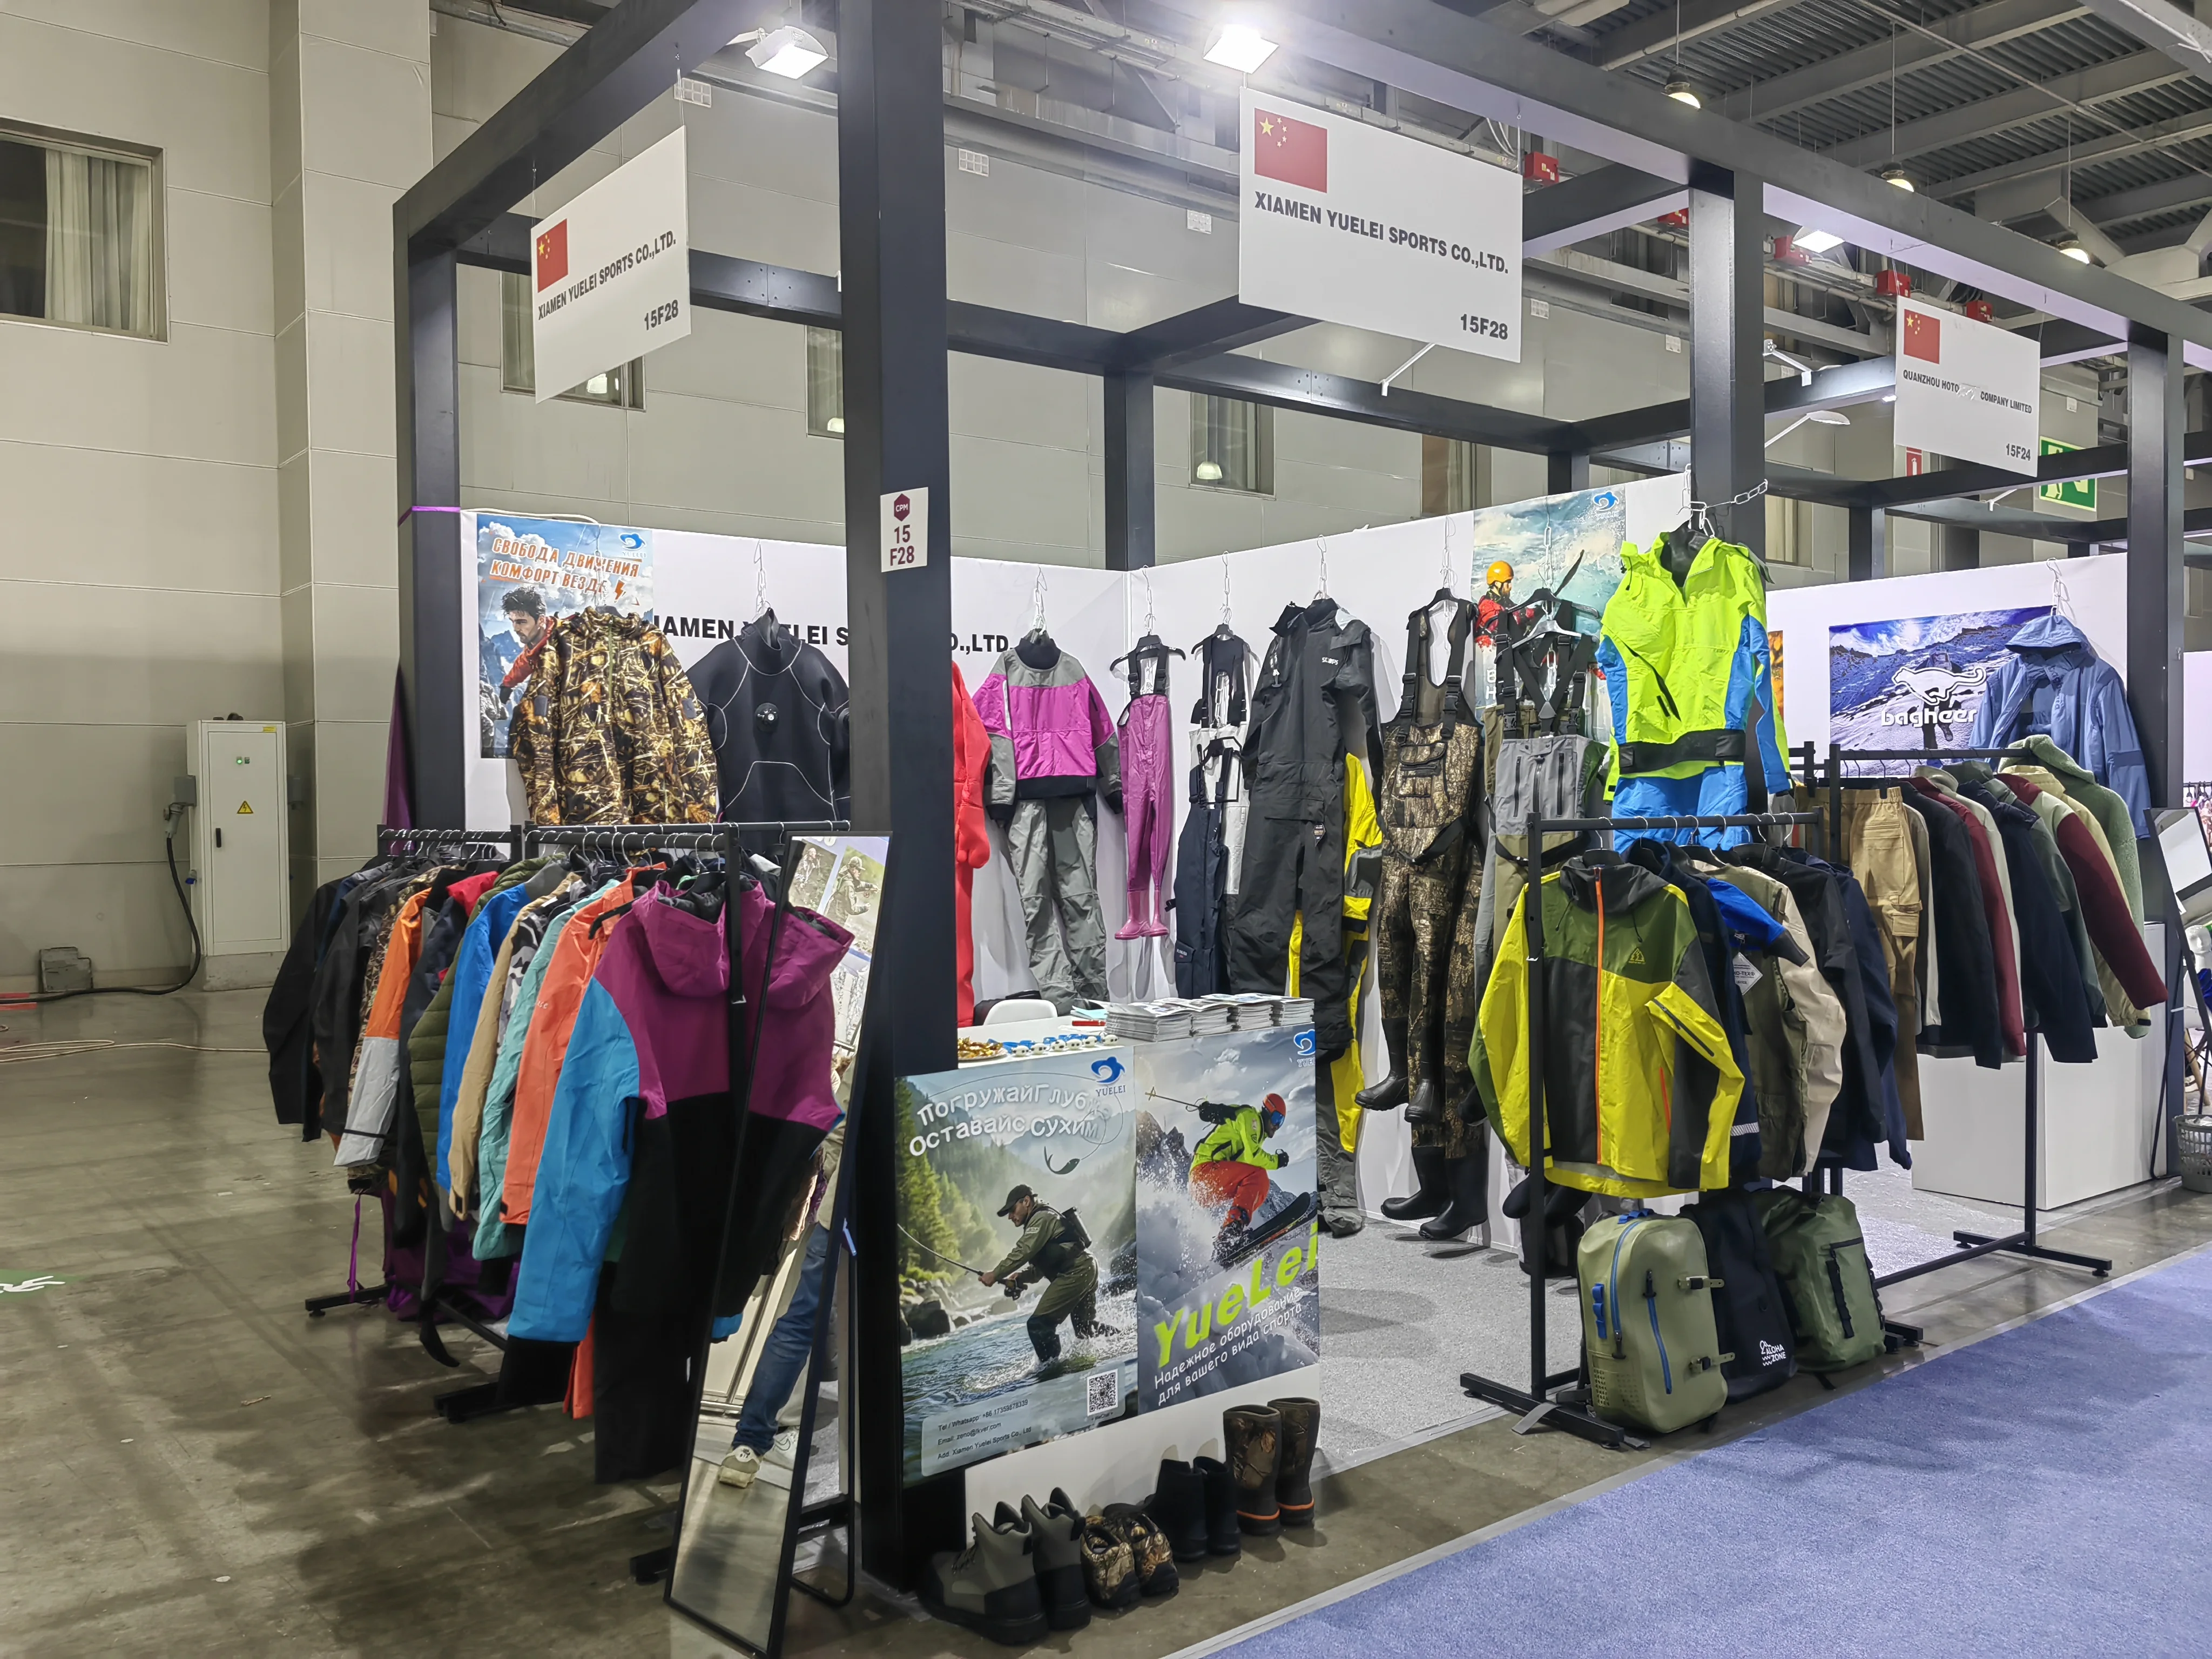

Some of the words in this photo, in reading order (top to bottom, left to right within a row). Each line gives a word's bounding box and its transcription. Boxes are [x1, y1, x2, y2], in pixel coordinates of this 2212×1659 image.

[1255, 191, 1321, 224] XIAMEN
[1327, 209, 1384, 240] YUELEI
[1388, 227, 1447, 257] SPORTS
[1451, 244, 1509, 274] CO.,LTD.
[538, 291, 567, 320] XIAMEN
[568, 273, 597, 303] YUELEI
[599, 253, 633, 285] SPORTS
[636, 231, 676, 264] CO.,LTD.
[644, 300, 679, 331] 15F28
[1460, 313, 1508, 340] 15F28
[1903, 369, 1940, 388] QUANZHOU
[1980, 391, 2009, 408] COMPANY
[2010, 399, 2032, 414] LIMITED
[2006, 443, 2031, 461] 15F24
[895, 503, 909, 512] CPM
[894, 524, 911, 544] 15
[493, 538, 558, 563] СВОБОДА
[890, 545, 915, 567] F28
[491, 559, 559, 585] КОМФОРТ
[654, 615, 734, 639] IAMEN
[1881, 707, 1977, 727] bagheer
[1096, 1085, 1126, 1097] YUELEI
[1155, 1340, 1216, 1390] Надежное
[1220, 1289, 1302, 1347] оборудование
[1766, 1344, 1785, 1355] ALOHA
[1158, 1381, 1181, 1406] для
[1185, 1351, 1228, 1386] вашего
[1232, 1331, 1259, 1356] вида
[1263, 1303, 1302, 1334] спорта
[1771, 1352, 1786, 1362] ZONE
[993, 1434, 1010, 1444] Sports
